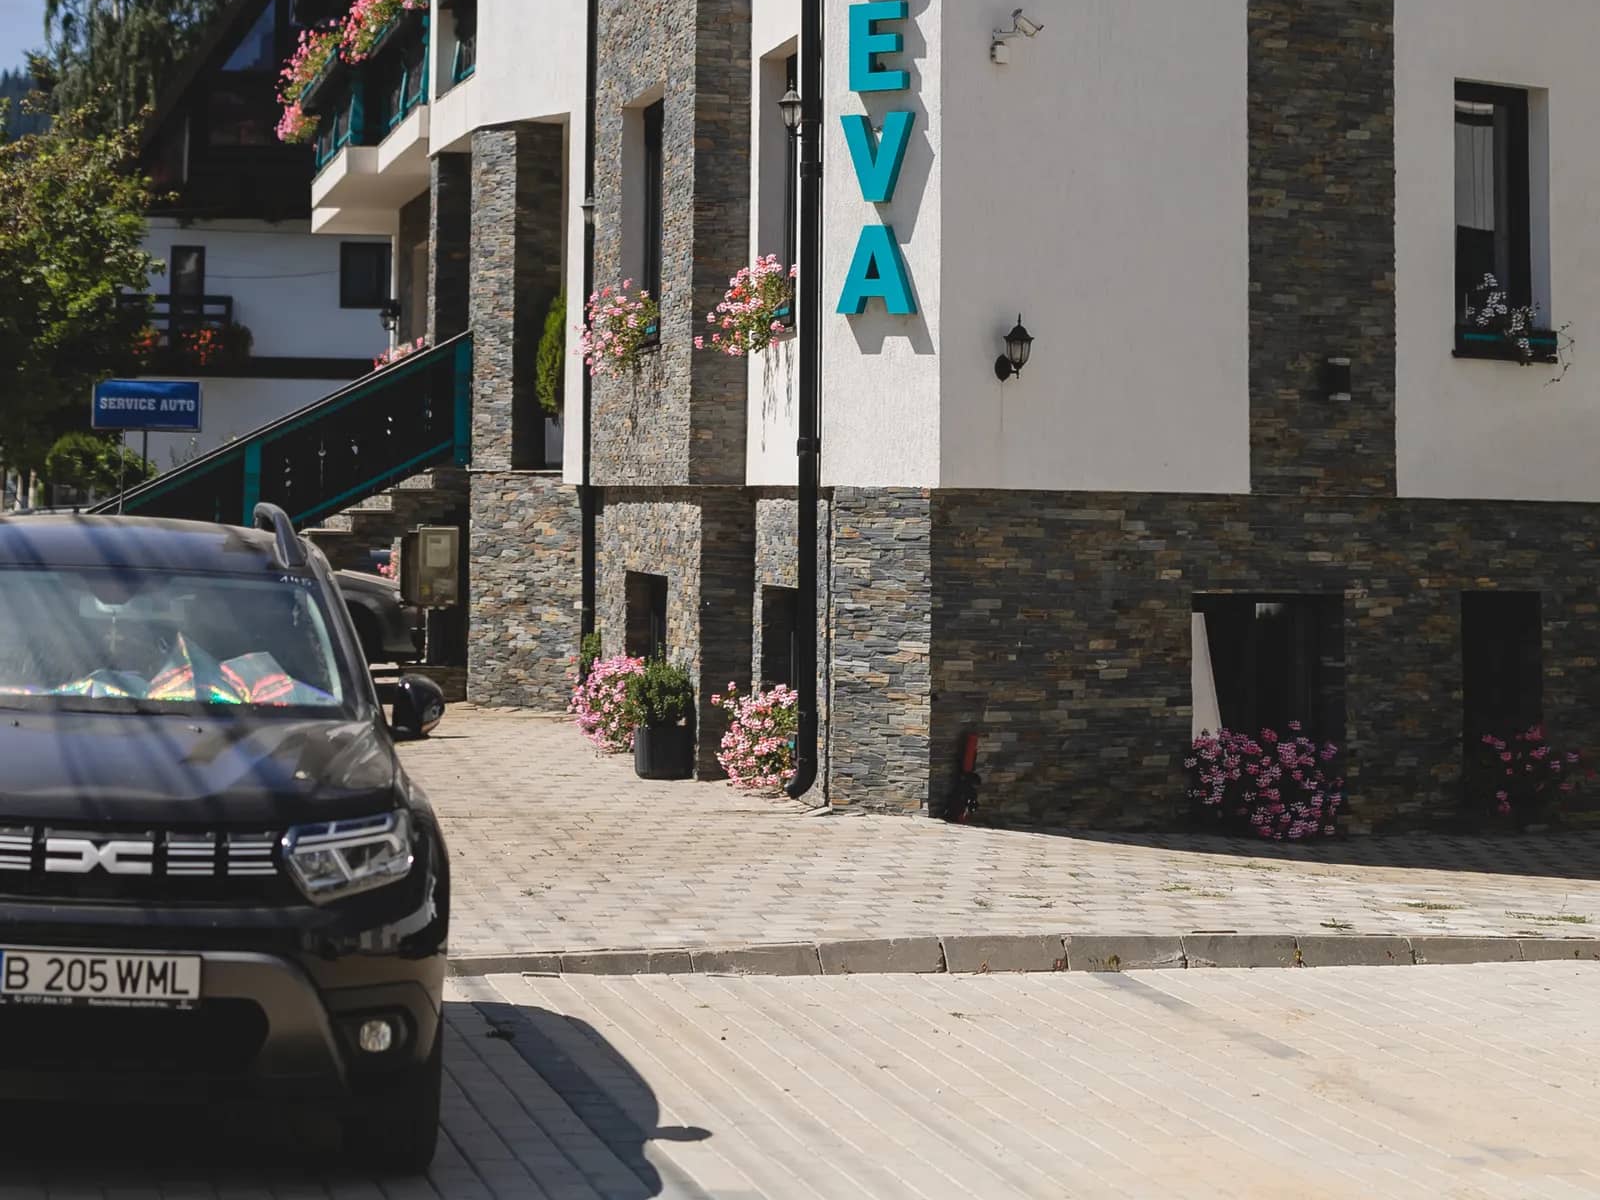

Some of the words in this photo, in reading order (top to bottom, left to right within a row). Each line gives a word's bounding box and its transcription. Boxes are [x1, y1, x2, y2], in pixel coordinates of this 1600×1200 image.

[99, 397, 156, 411] SERVICE
[159, 399, 196, 412] AUTO
[5, 956, 29, 991] B
[45, 957, 108, 993] 205
[116, 959, 190, 995] WML
